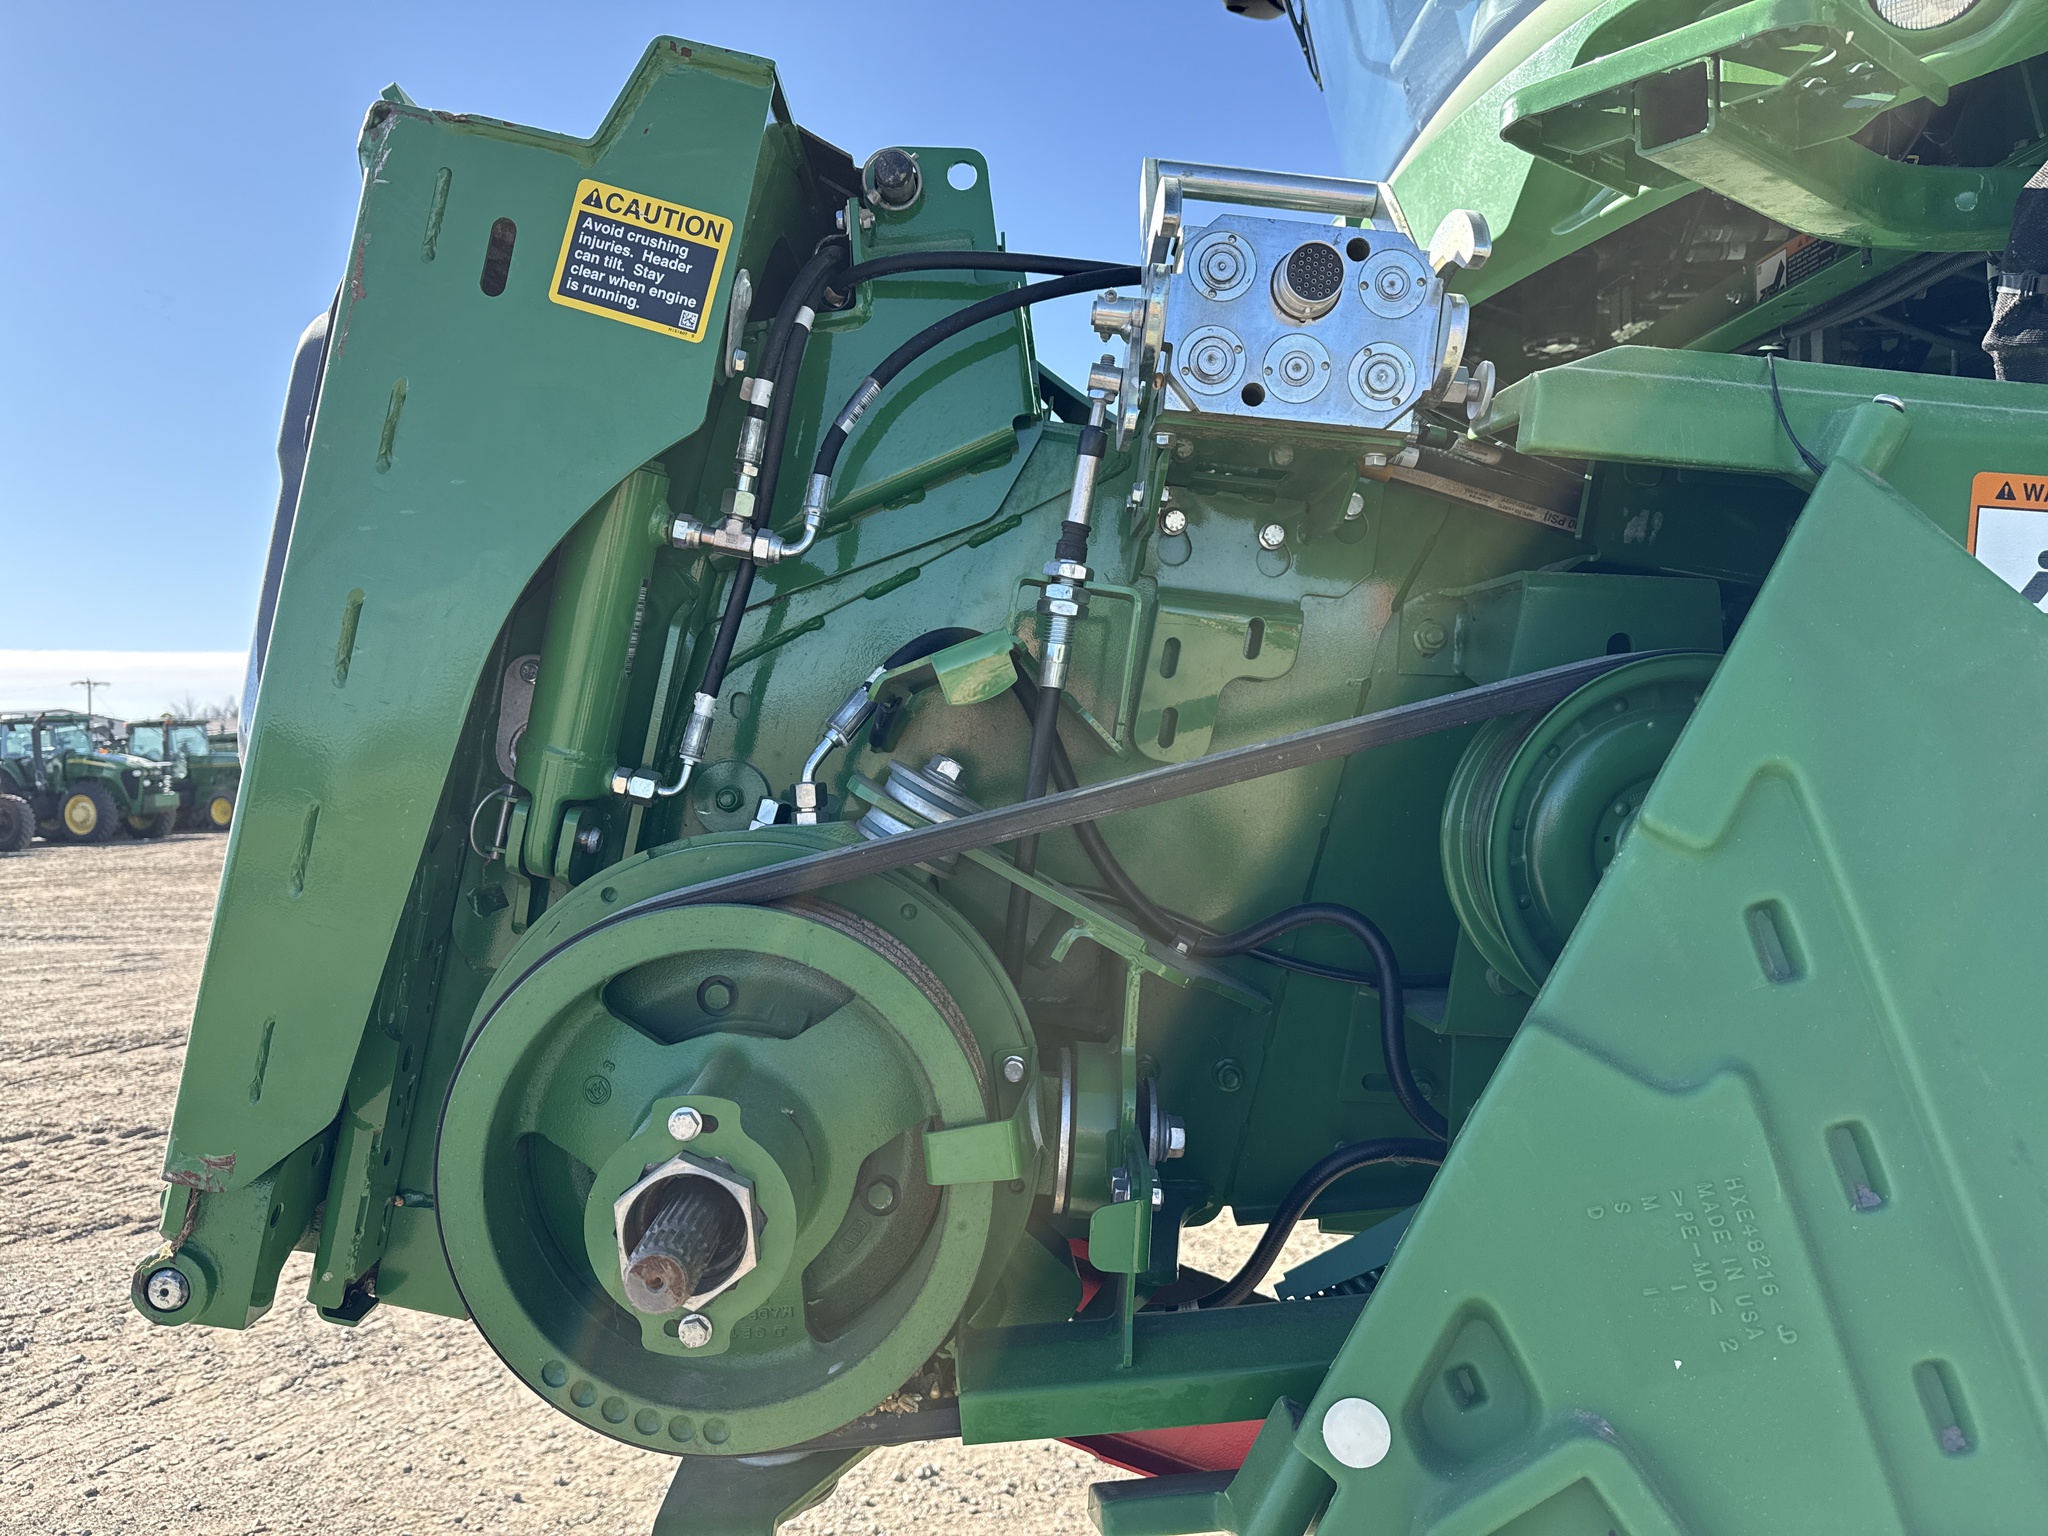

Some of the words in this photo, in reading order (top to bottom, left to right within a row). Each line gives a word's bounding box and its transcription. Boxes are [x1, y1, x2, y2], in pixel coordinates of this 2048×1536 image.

[582, 217, 625, 239] Avoid
[626, 230, 690, 260] crushing
[605, 192, 725, 243] CAUTION
[574, 250, 600, 265] can
[603, 254, 626, 272] tilt.
[633, 263, 665, 285] Stay
[578, 231, 635, 258] injuries.
[642, 250, 693, 275] Header
[566, 277, 579, 292] is
[582, 283, 640, 310] running.
[570, 264, 606, 282] clear
[608, 275, 646, 294] when
[649, 287, 697, 309] engine
[1586, 1205, 1604, 1220] D
[1614, 1202, 1632, 1214] S
[1640, 1195, 1661, 1212] M
[1724, 1177, 1780, 1296] HXE48216
[1696, 1182, 1733, 1244] MADE
[1720, 1257, 1745, 1282] IN
[1735, 1294, 1765, 1341] USA
